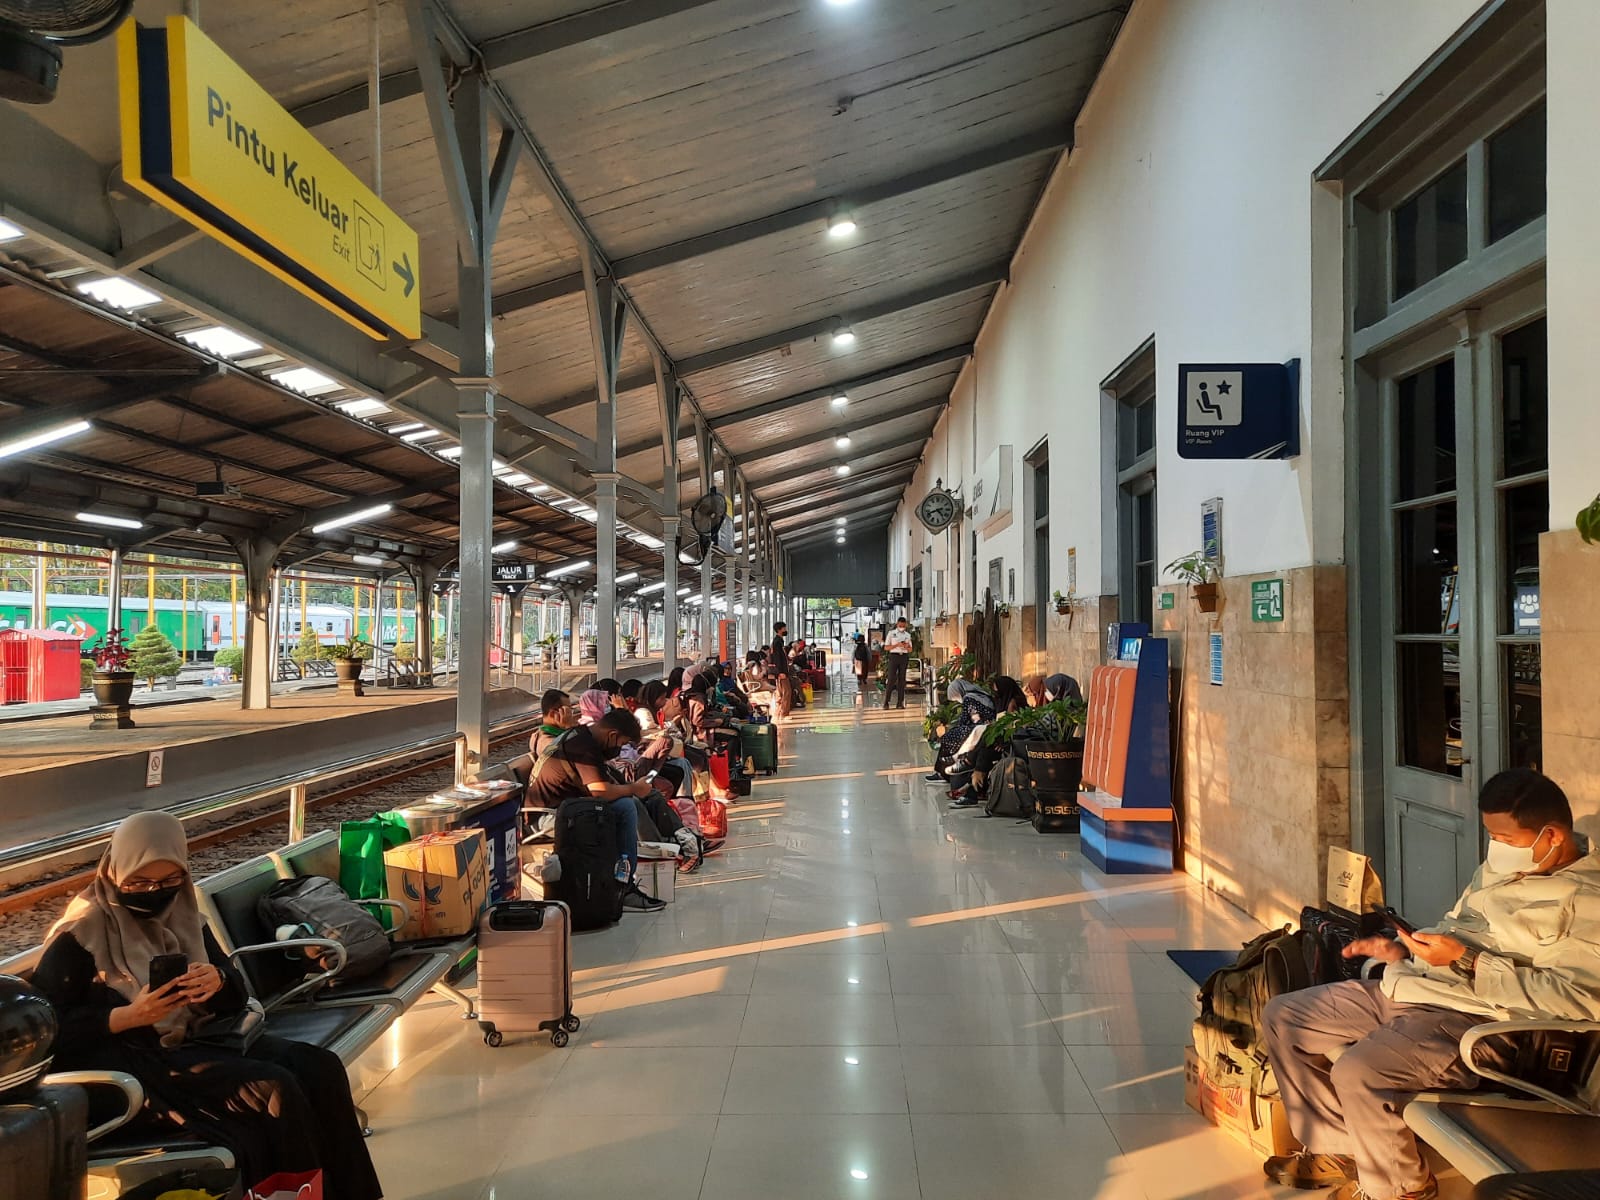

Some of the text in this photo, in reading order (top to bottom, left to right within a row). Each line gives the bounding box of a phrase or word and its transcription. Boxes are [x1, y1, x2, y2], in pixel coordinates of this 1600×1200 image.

[207, 86, 349, 234] Pintu Keluar
[332, 234, 350, 262] Exit
[1185, 429, 1210, 438] Ruang
[496, 566, 522, 575] JALUR
[432, 583, 441, 592] 2
[506, 584, 516, 593] 1
